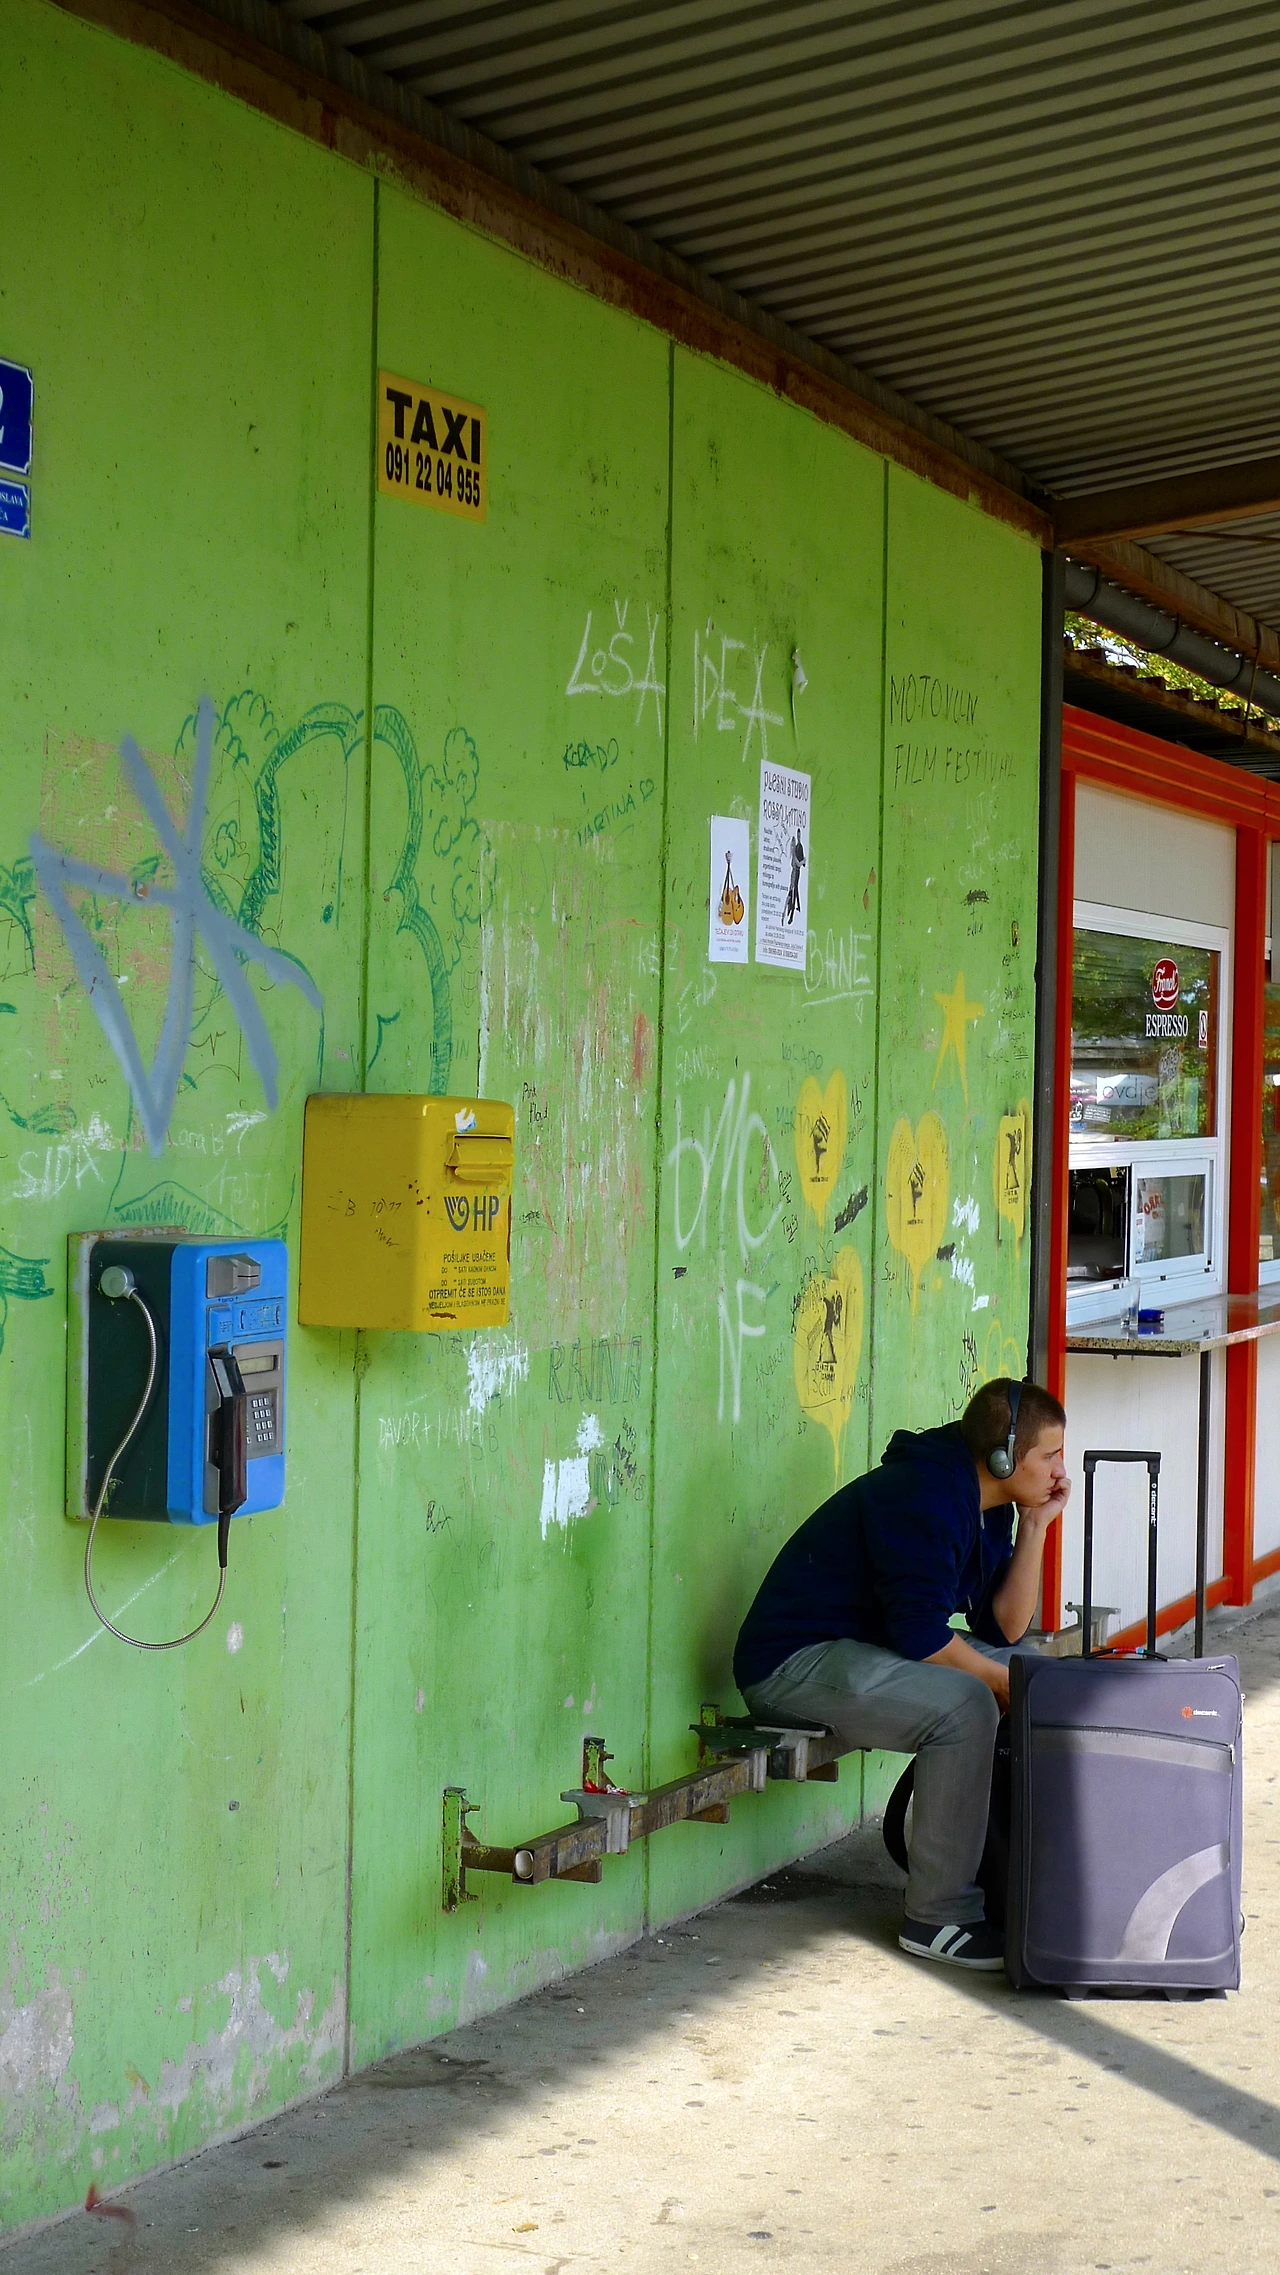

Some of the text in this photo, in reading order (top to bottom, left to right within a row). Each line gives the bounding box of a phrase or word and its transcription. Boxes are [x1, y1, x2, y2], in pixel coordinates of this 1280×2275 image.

[386, 387, 481, 465] TAXI
[386, 442, 480, 508] 091 22 04 955
[894, 743, 938, 791] FILM
[804, 926, 871, 993] BANE
[1145, 1014, 1189, 1037] ESPRESSO
[1102, 1078, 1157, 1106] ovdje
[473, 1195, 500, 1231] HP
[443, 1250, 470, 1263] POŠILJKE
[428, 1288, 457, 1300] OTPREMIT
